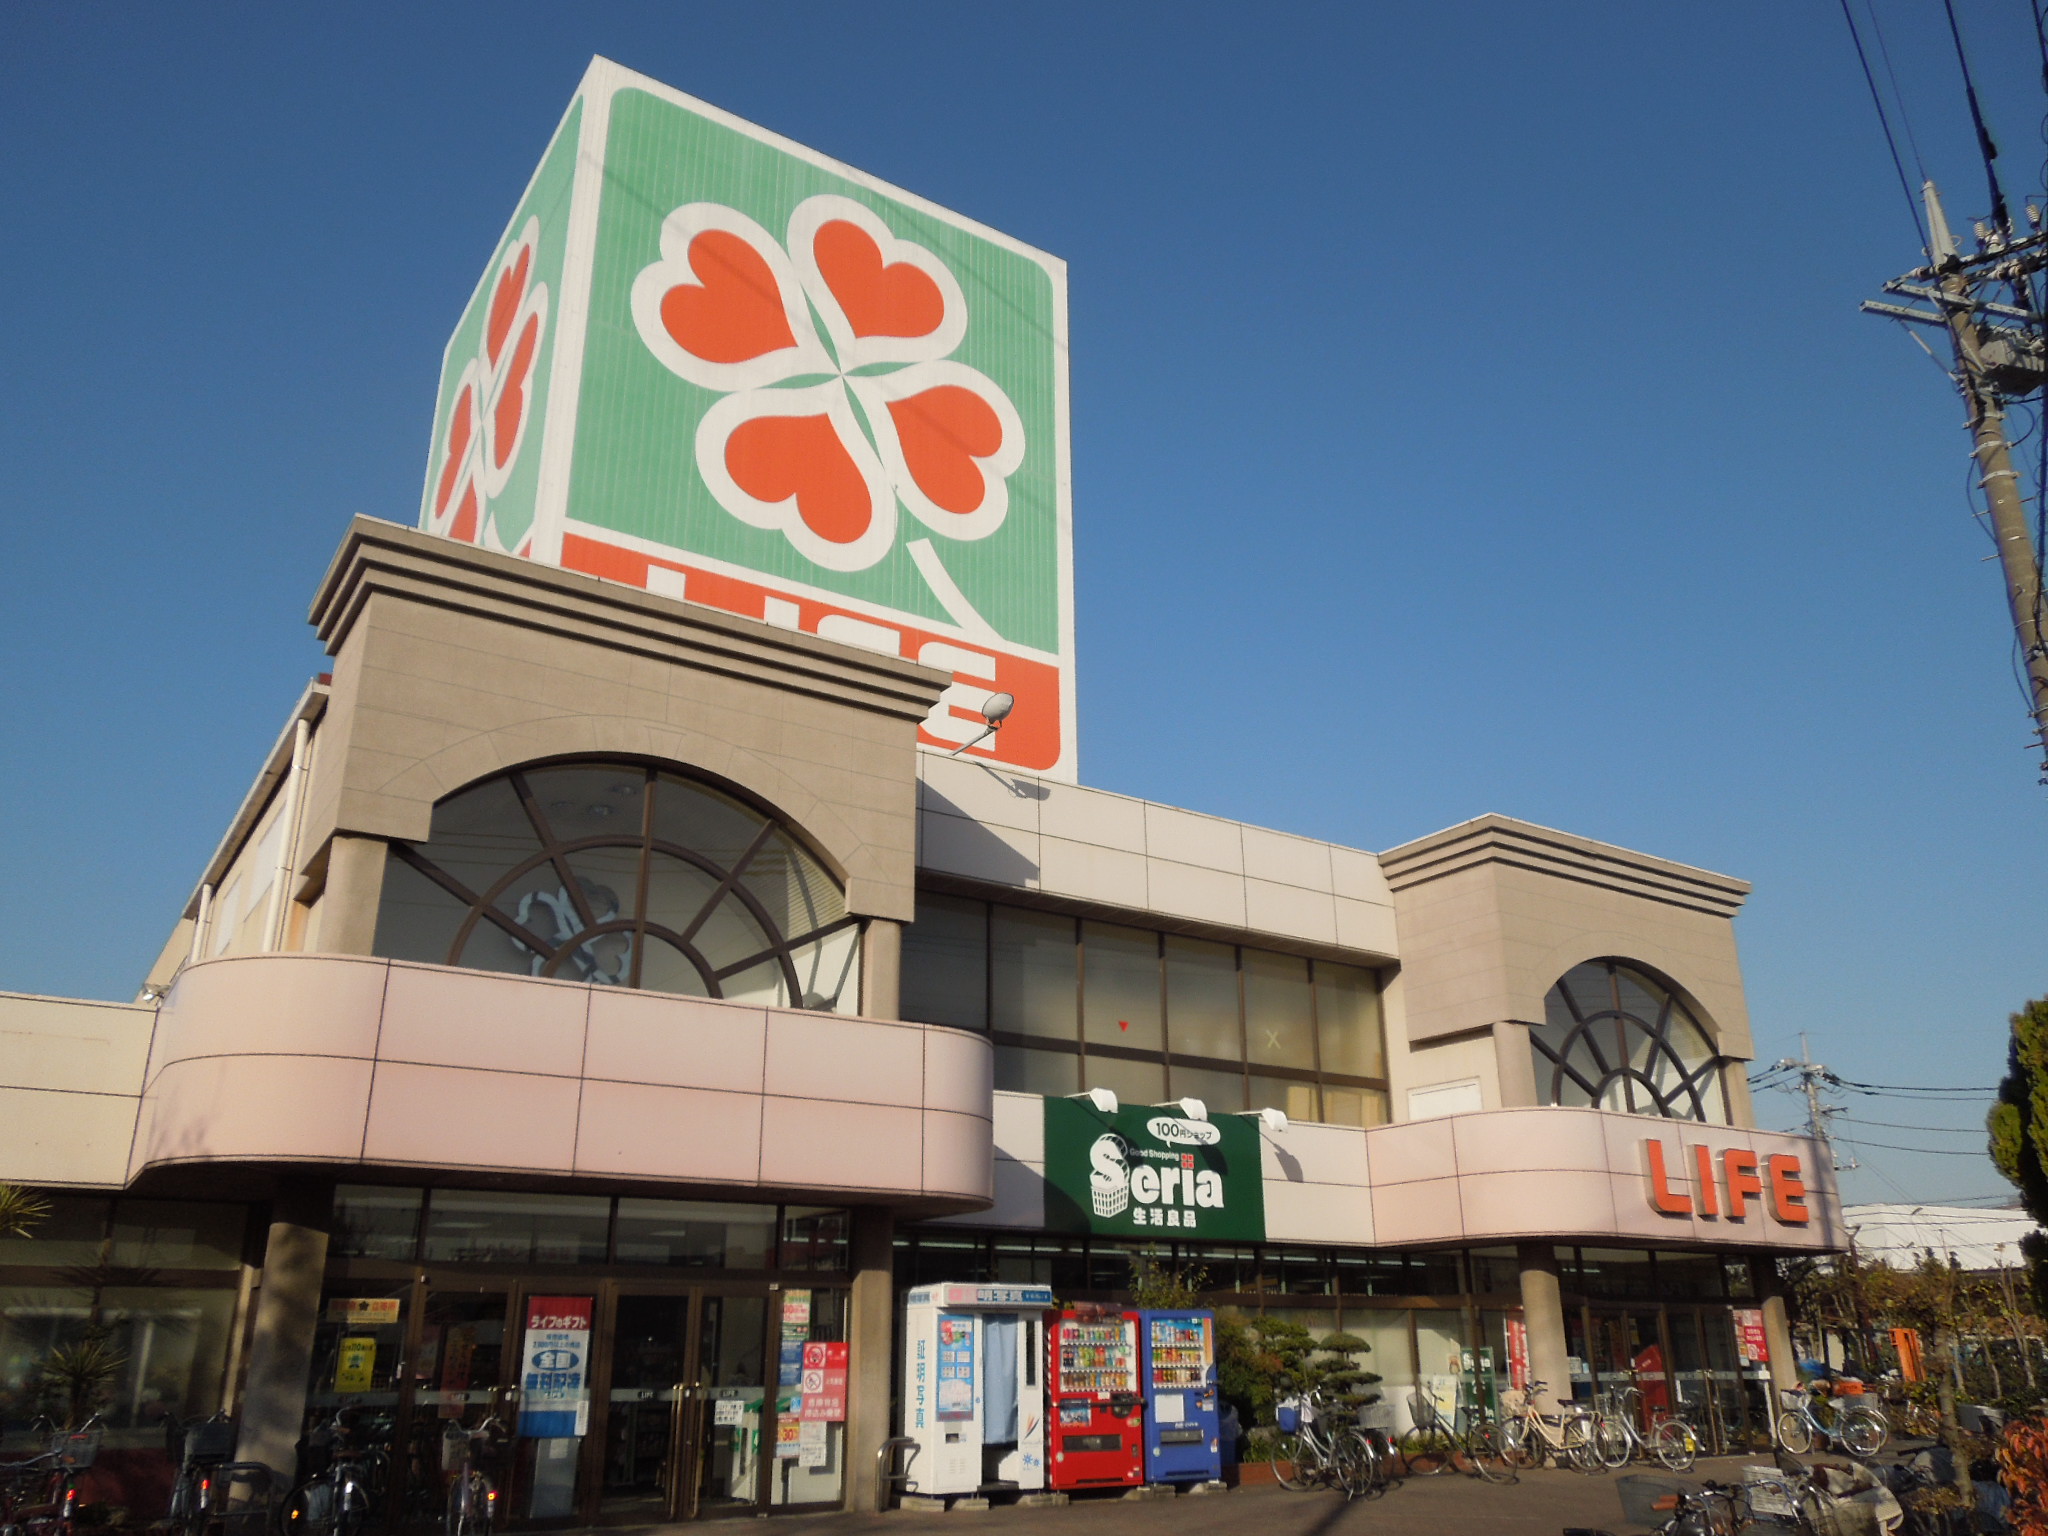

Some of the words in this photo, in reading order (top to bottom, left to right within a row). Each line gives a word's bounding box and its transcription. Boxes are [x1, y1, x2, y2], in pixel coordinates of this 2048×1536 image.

[1155, 1122, 1213, 1140] 100円ショップ
[1129, 1147, 1148, 1158] Good
[1149, 1149, 1180, 1162] Shopping
[1090, 1134, 1224, 1209] Seria
[1640, 1138, 1809, 1223] LIFE
[1133, 1207, 1197, 1228] 生活良品
[531, 1315, 587, 1329] ライフのギフト
[539, 1352, 571, 1368] 全国
[915, 1339, 926, 1429] 証明写真
